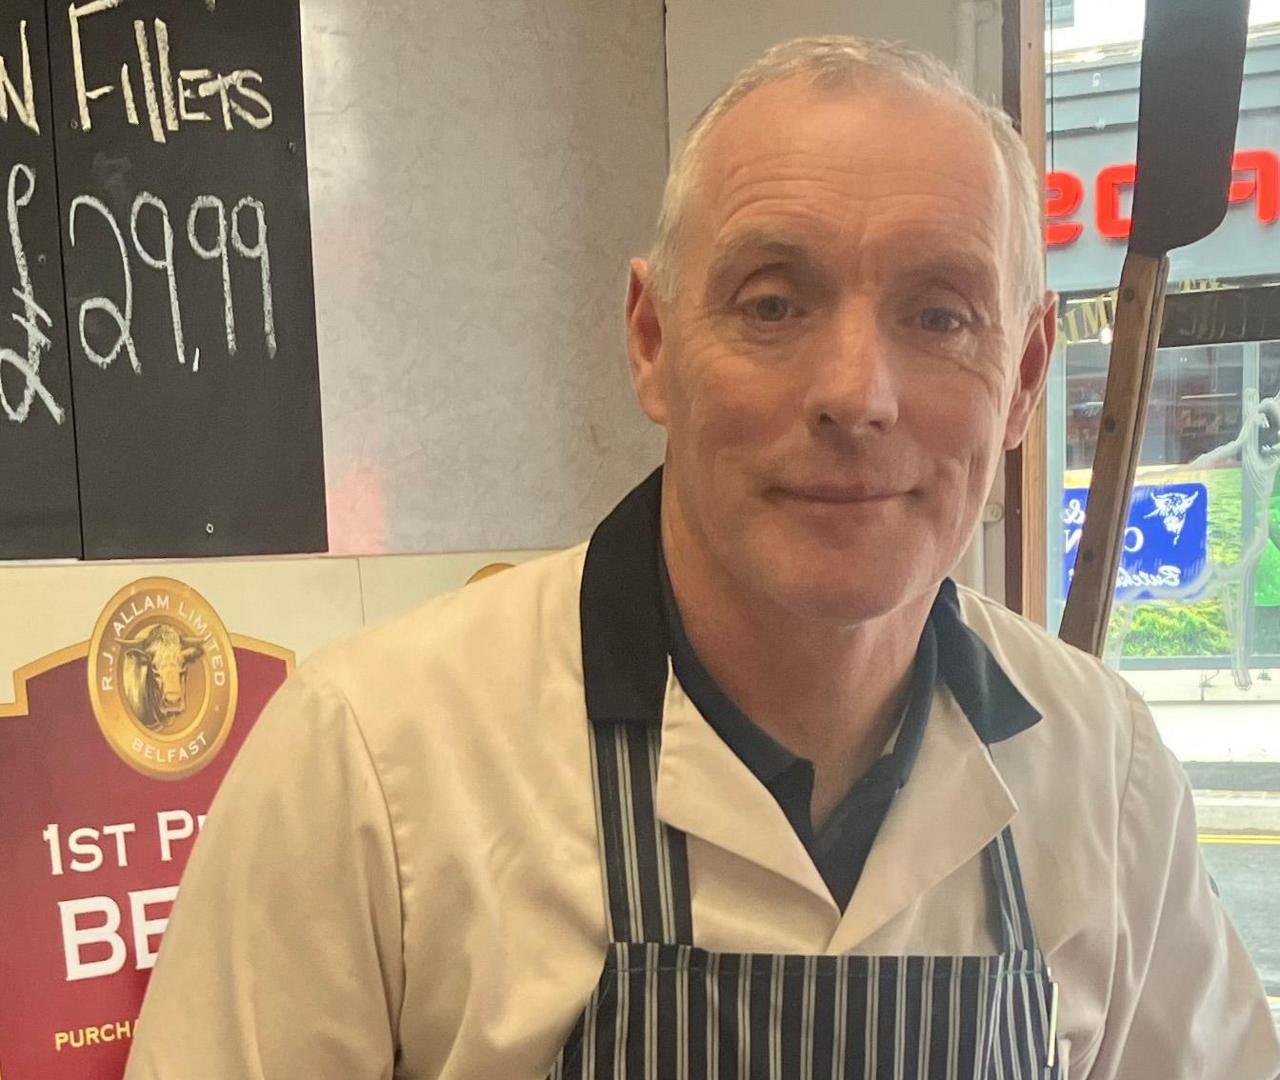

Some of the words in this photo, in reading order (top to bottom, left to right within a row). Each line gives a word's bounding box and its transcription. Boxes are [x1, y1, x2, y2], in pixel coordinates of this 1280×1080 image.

[113, 594, 170, 637] ALLAM
[178, 602, 226, 686] LIMITED
[131, 731, 208, 764] BELFAST
[42, 822, 136, 876] 1ST
